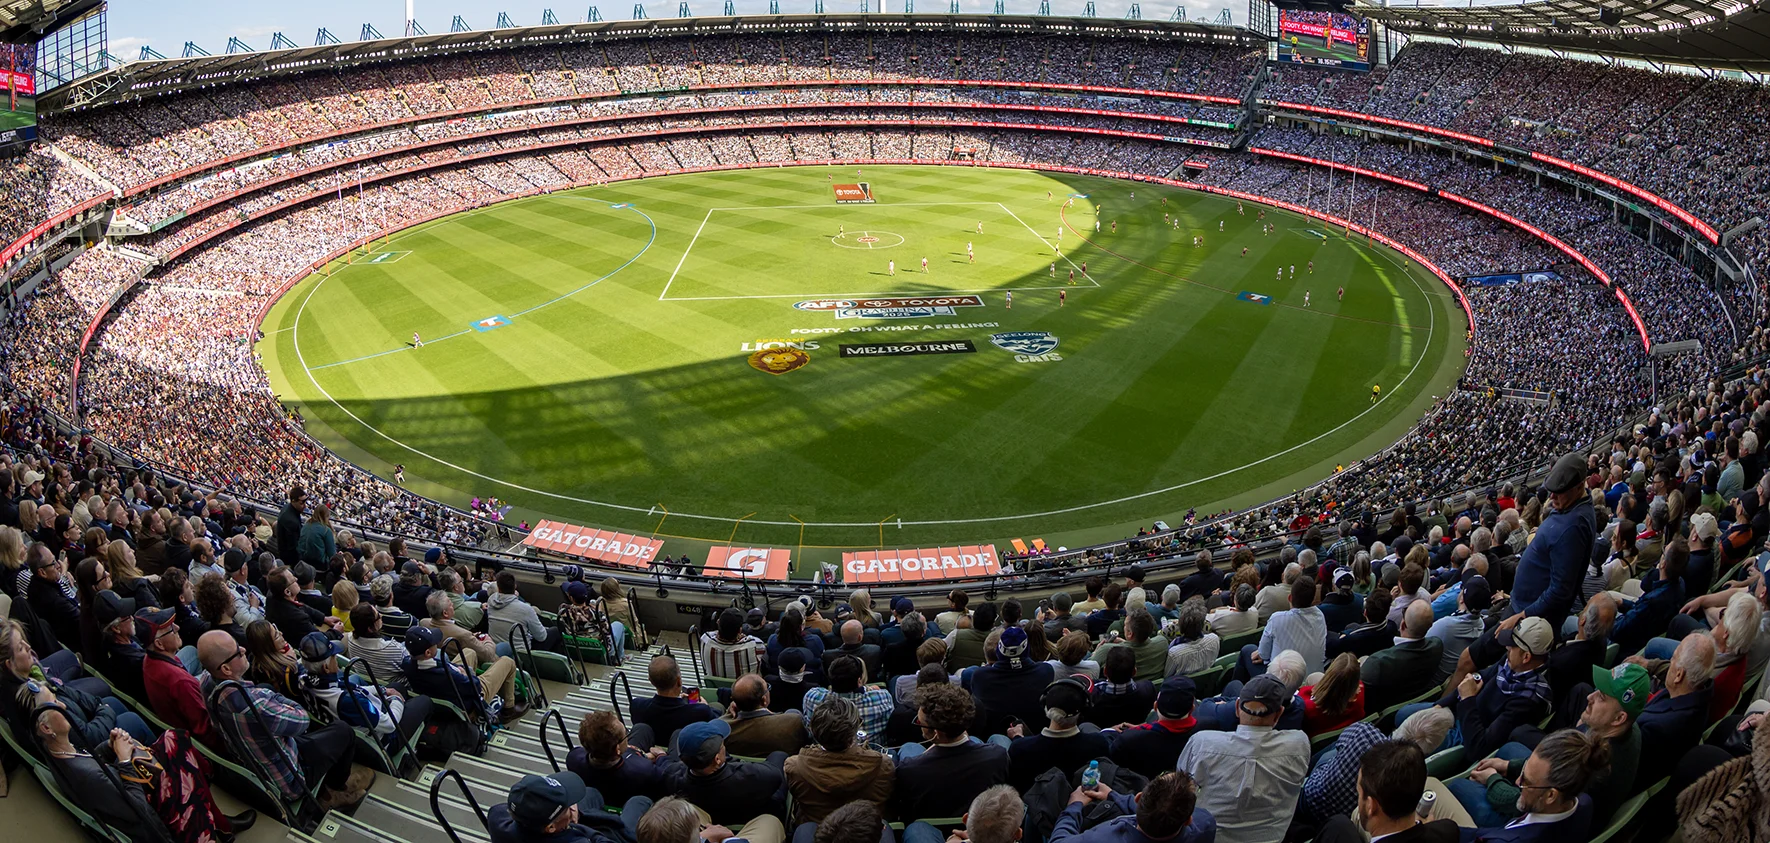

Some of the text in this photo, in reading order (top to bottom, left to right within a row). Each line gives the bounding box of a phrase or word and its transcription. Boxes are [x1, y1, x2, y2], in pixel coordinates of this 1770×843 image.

[896, 298, 975, 306] TOYOTA
[936, 322, 999, 330] FEELING!
[741, 341, 820, 350] LIONS
[846, 343, 968, 355] MELBOURNE
[1014, 352, 1064, 363] CATS
[533, 527, 654, 559] GATORADE
[727, 549, 769, 577] G
[846, 552, 994, 574] GATORADE
[325, 823, 335, 832] G
